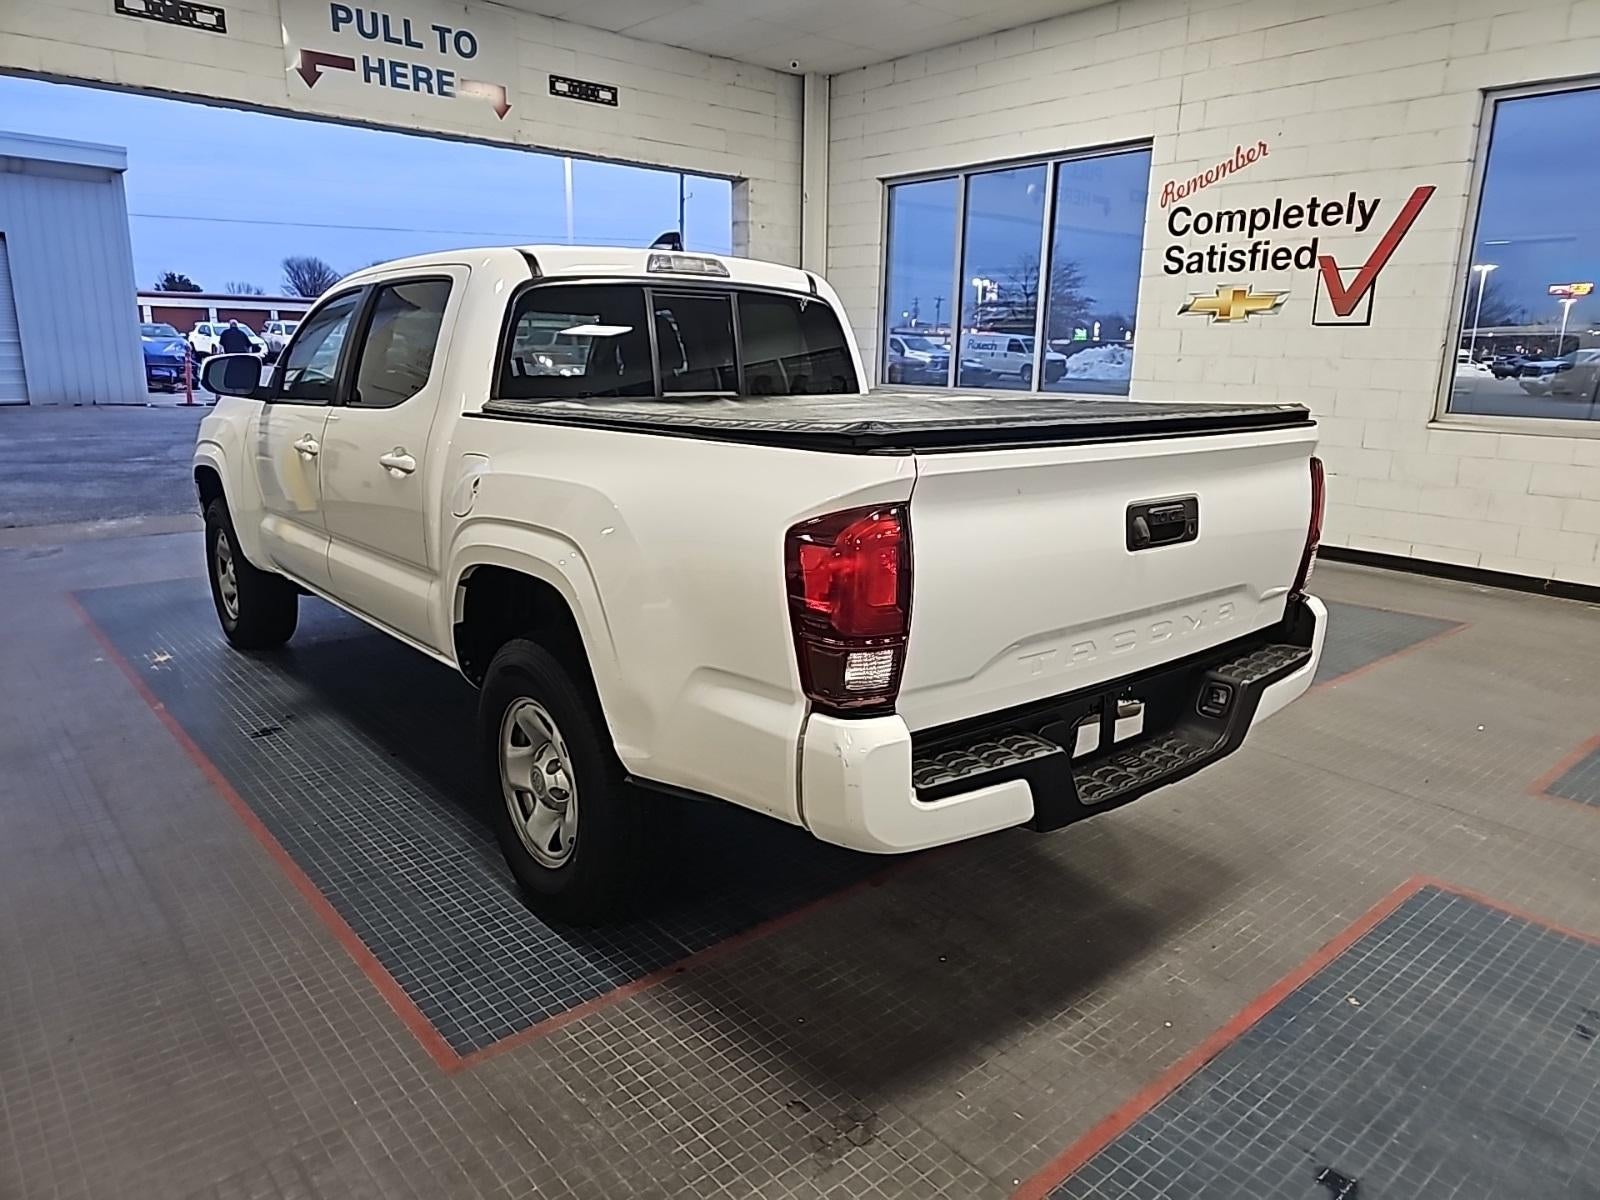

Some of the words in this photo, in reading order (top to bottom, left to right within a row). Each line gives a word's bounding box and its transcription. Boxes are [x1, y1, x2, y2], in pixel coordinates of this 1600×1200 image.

[330, 3, 424, 49] PULL
[431, 24, 479, 58] TO
[361, 55, 457, 98] HERE
[1160, 141, 1269, 208] Remember
[1168, 191, 1381, 239] Completely
[1163, 237, 1319, 275] Satisfied
[1018, 602, 1236, 676] TACOMA
